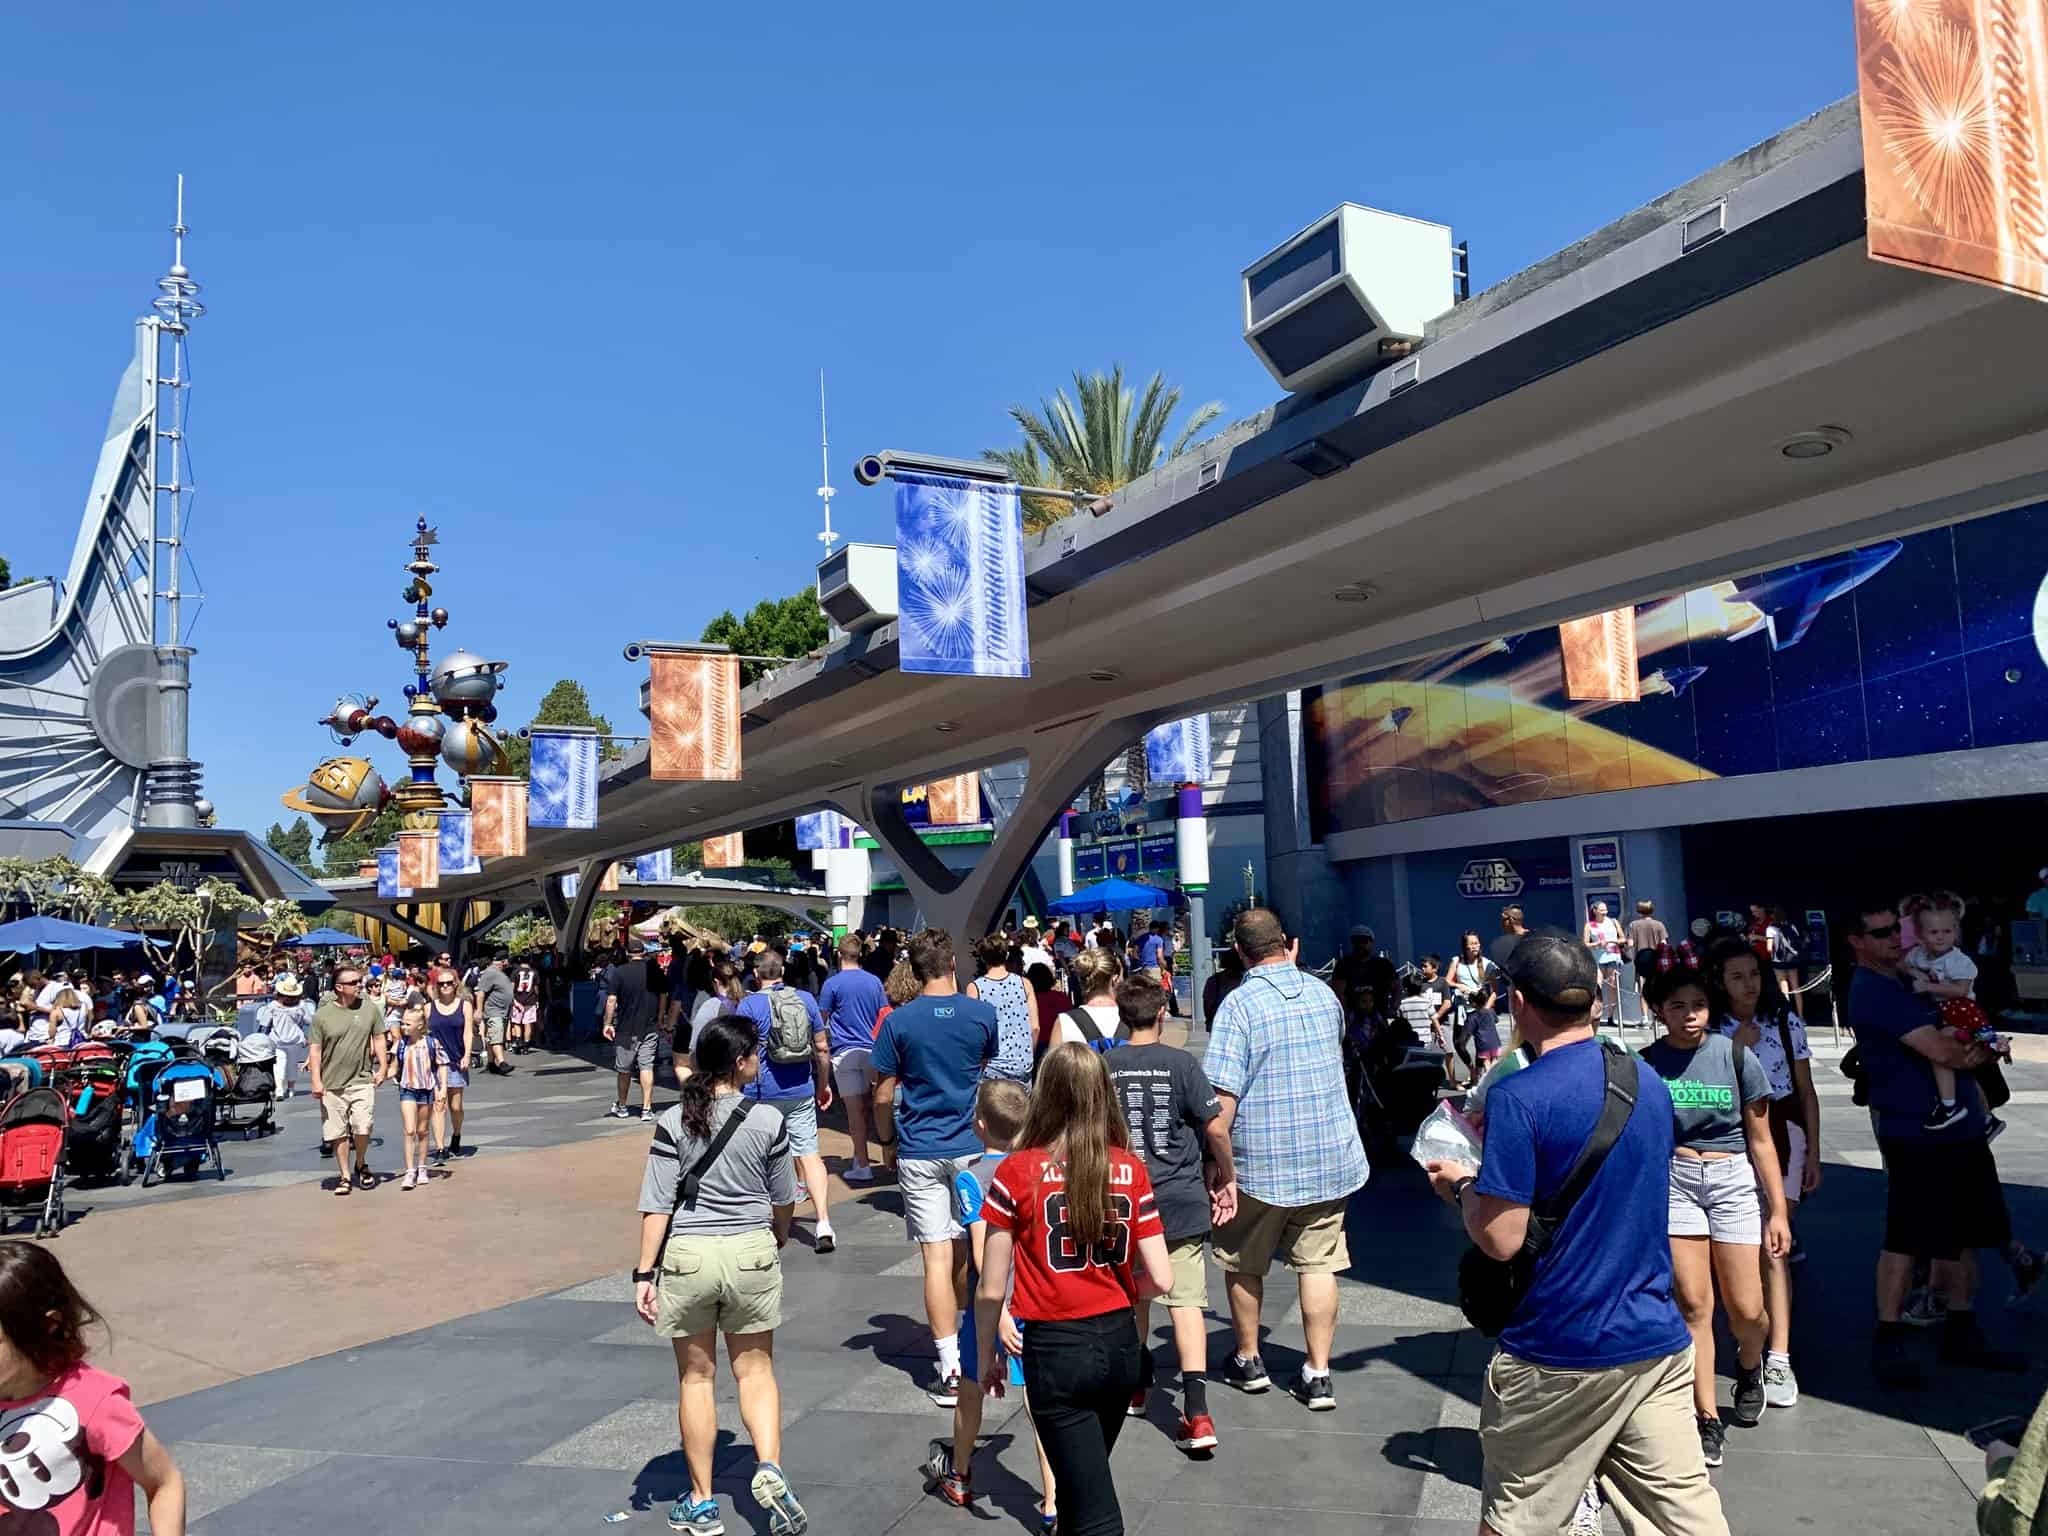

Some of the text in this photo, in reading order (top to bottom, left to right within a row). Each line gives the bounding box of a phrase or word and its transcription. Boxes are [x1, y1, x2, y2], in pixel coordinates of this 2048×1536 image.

[160, 862, 200, 877] STAR
[1470, 863, 1506, 878] STAR
[1465, 877, 1515, 893] TOURS
[1671, 1089, 1733, 1103] OXING
